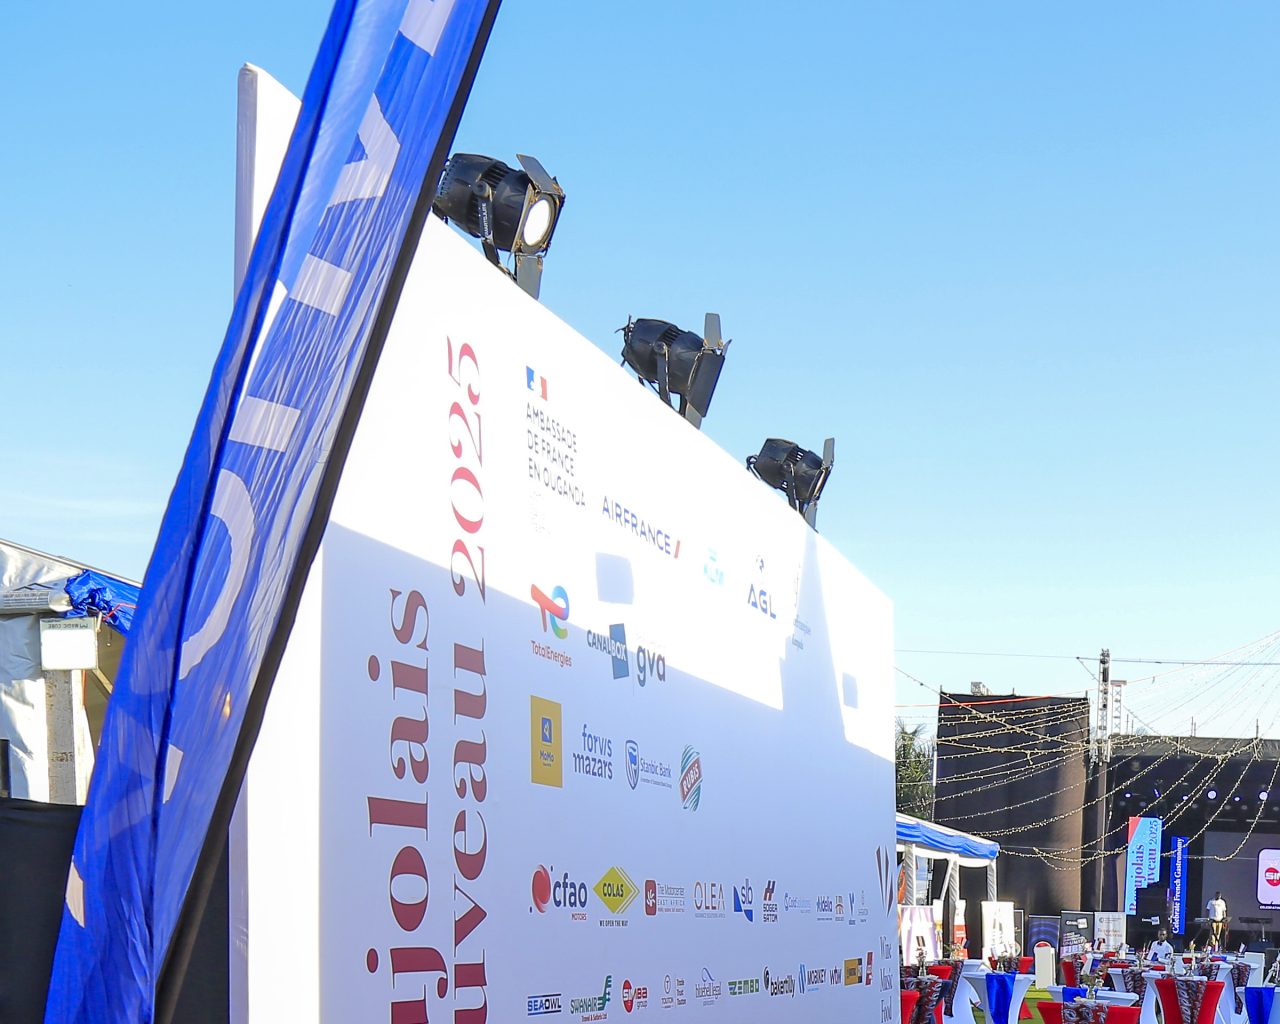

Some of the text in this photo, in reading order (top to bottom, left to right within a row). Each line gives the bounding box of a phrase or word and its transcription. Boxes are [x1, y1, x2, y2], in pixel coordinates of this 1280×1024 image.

[526, 402, 577, 453] AMBASSADE
[447, 335, 485, 605] 2025
[527, 429, 575, 477] DE FRANCE
[528, 457, 586, 506] EN OUGANDA
[602, 496, 671, 555] AIRFRANCE
[748, 583, 777, 619] AGL
[531, 640, 572, 668] TotalEnergies
[637, 646, 666, 687] gva
[572, 753, 613, 780] mazars
[640, 757, 672, 779] Stanbic Bank
[682, 763, 700, 796] RUBIS
[1149, 820, 1158, 845] 2025
[553, 872, 588, 908] cfao
[602, 883, 624, 898] COLAS
[694, 881, 726, 910] OLEA
[741, 878, 754, 905] slb
[1172, 837, 1184, 934] Celebrate French Gastronomy
[527, 998, 562, 1012] SEAOWL
